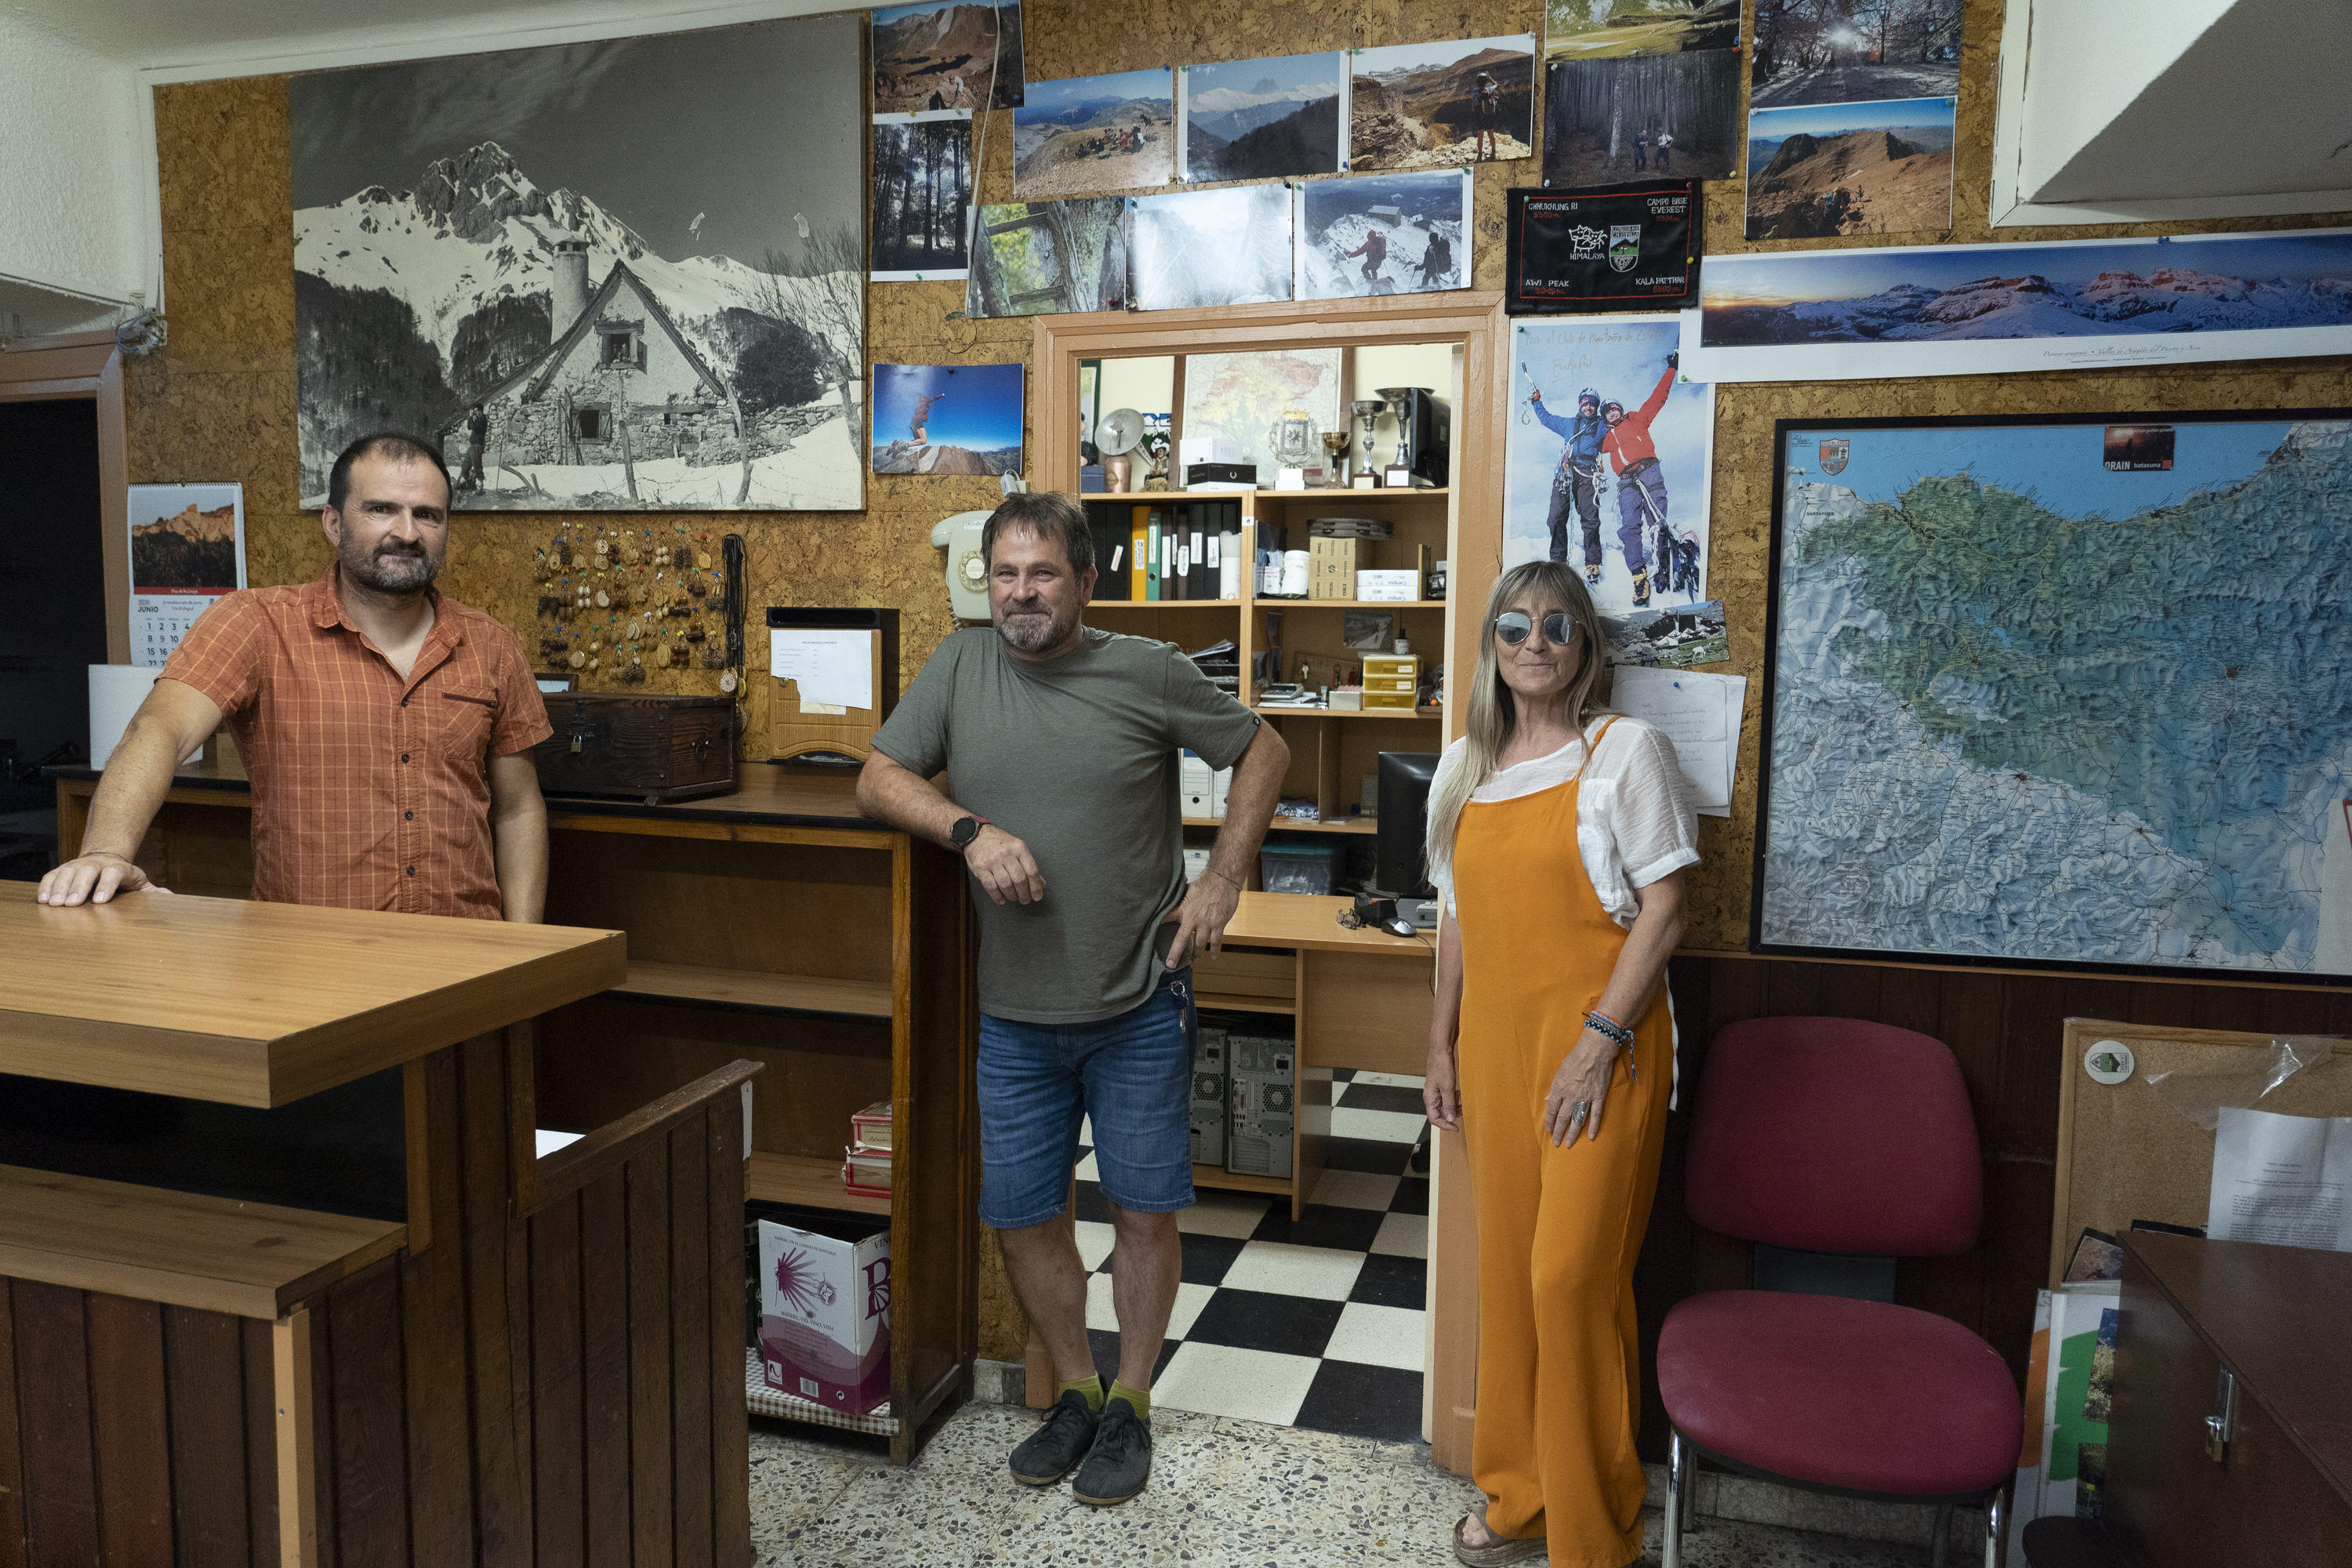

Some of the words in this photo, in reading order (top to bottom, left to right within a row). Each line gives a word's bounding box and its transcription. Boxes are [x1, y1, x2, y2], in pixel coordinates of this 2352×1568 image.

[1647, 198, 1669, 206] CAMPO
[1671, 197, 1688, 205] BASE
[1651, 205, 1686, 214] EVEREST
[1570, 252, 1606, 260] HIMALAYA
[1655, 276, 1685, 285] PATTHAR
[818, 1247, 837, 1256] SANTIAGO
